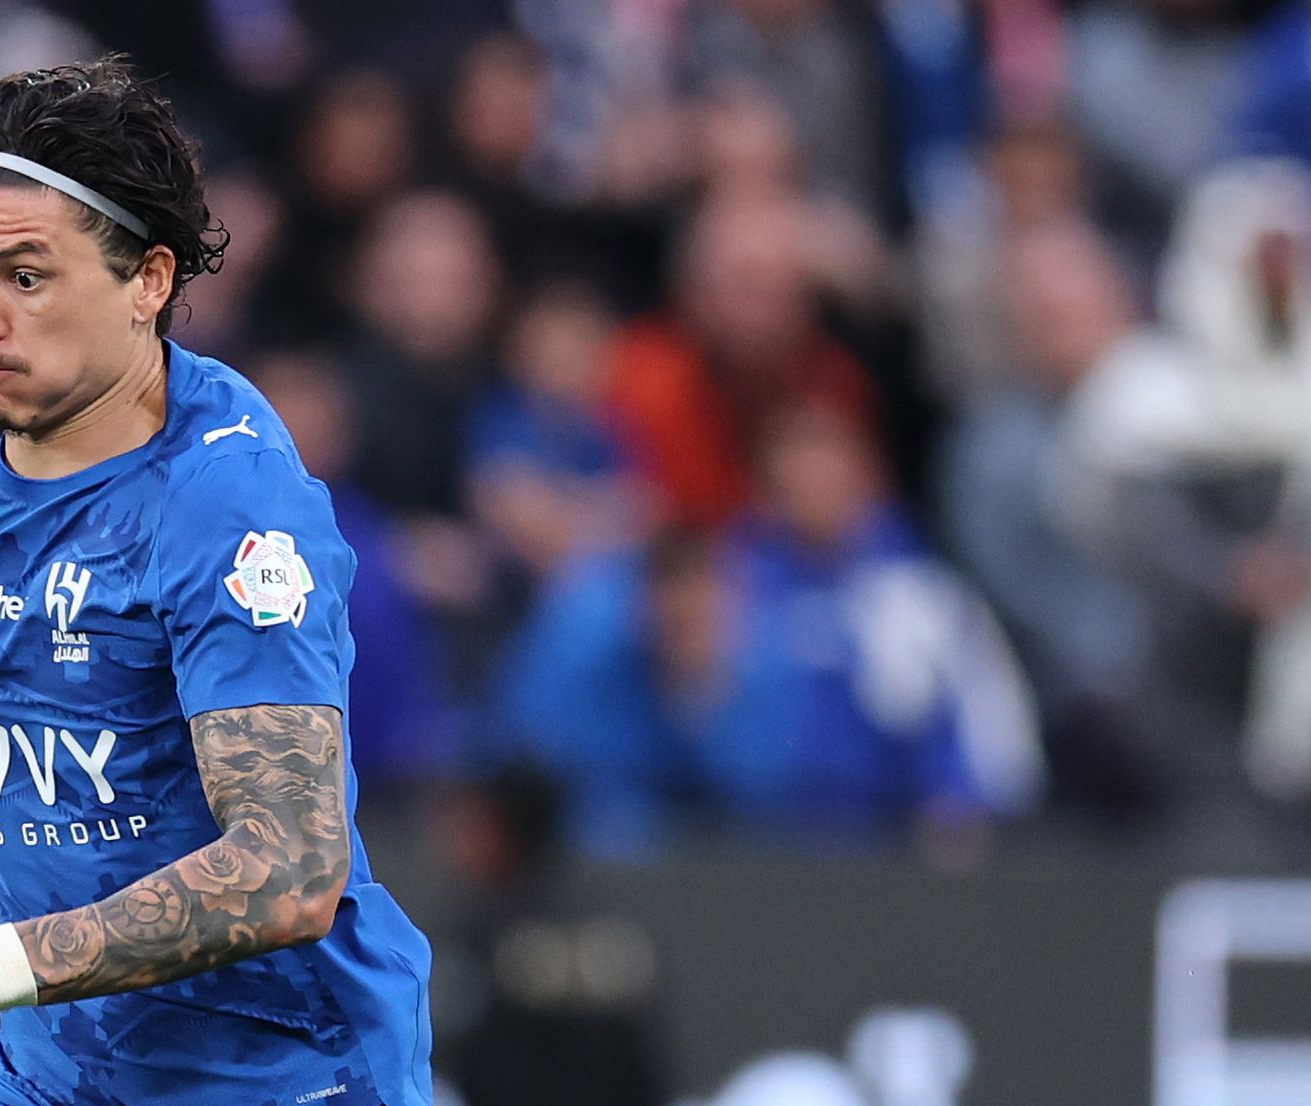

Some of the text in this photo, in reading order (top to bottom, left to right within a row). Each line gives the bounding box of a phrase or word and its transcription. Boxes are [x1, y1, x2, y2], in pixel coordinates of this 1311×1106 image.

[260, 568, 290, 586] RSL
[22, 815, 147, 846] GROUP
[295, 1083, 348, 1104] ULTRAWEAVE
